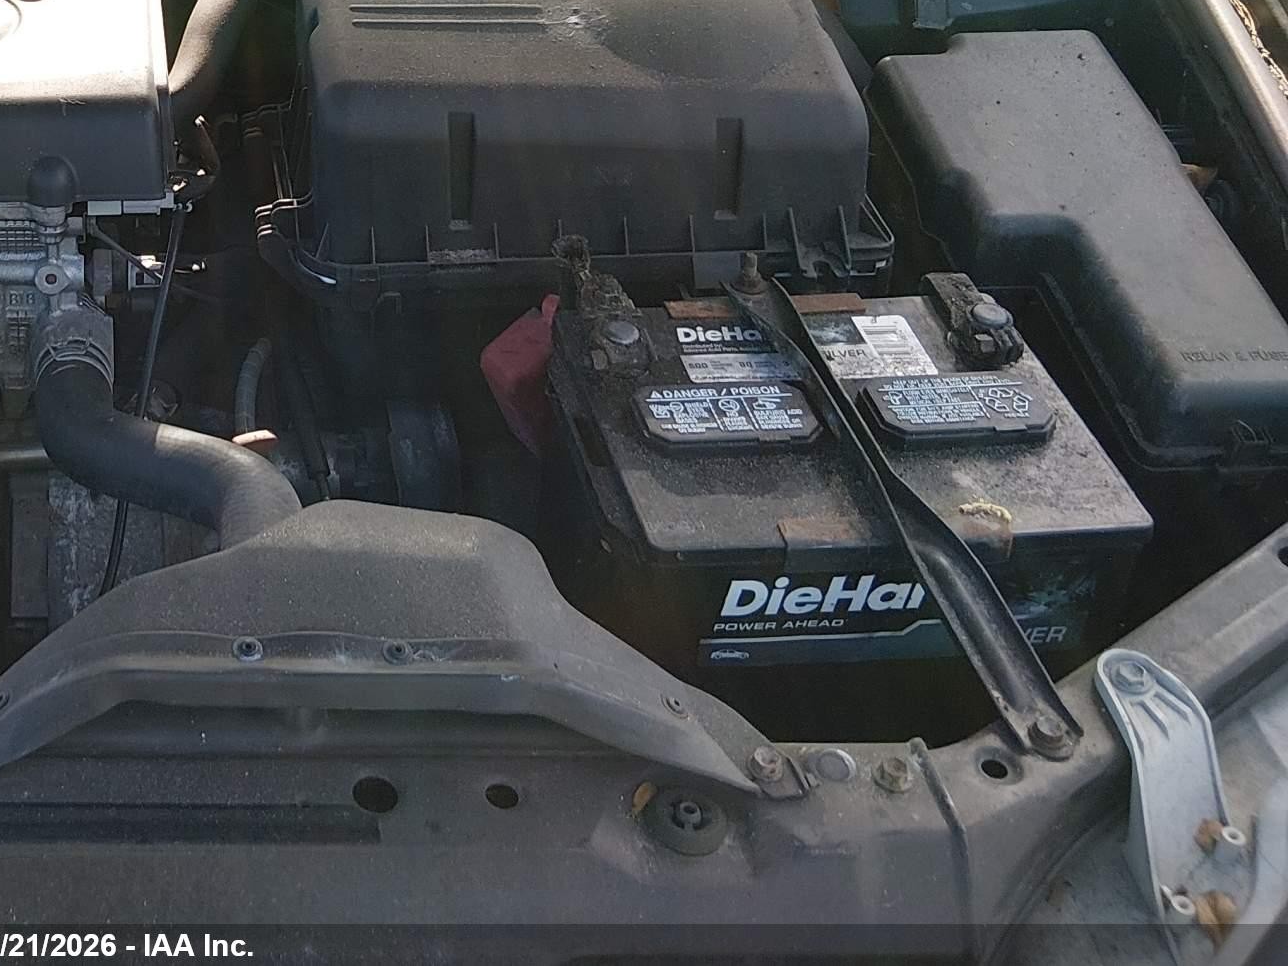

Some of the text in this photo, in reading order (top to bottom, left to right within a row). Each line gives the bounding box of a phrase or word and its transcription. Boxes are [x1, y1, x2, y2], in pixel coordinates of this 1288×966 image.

[676, 325, 762, 343] DieHa
[662, 388, 718, 399] DANGER
[730, 385, 781, 396] POISON
[720, 574, 926, 617] DieHar
[713, 618, 845, 632] POWER AHEAD
